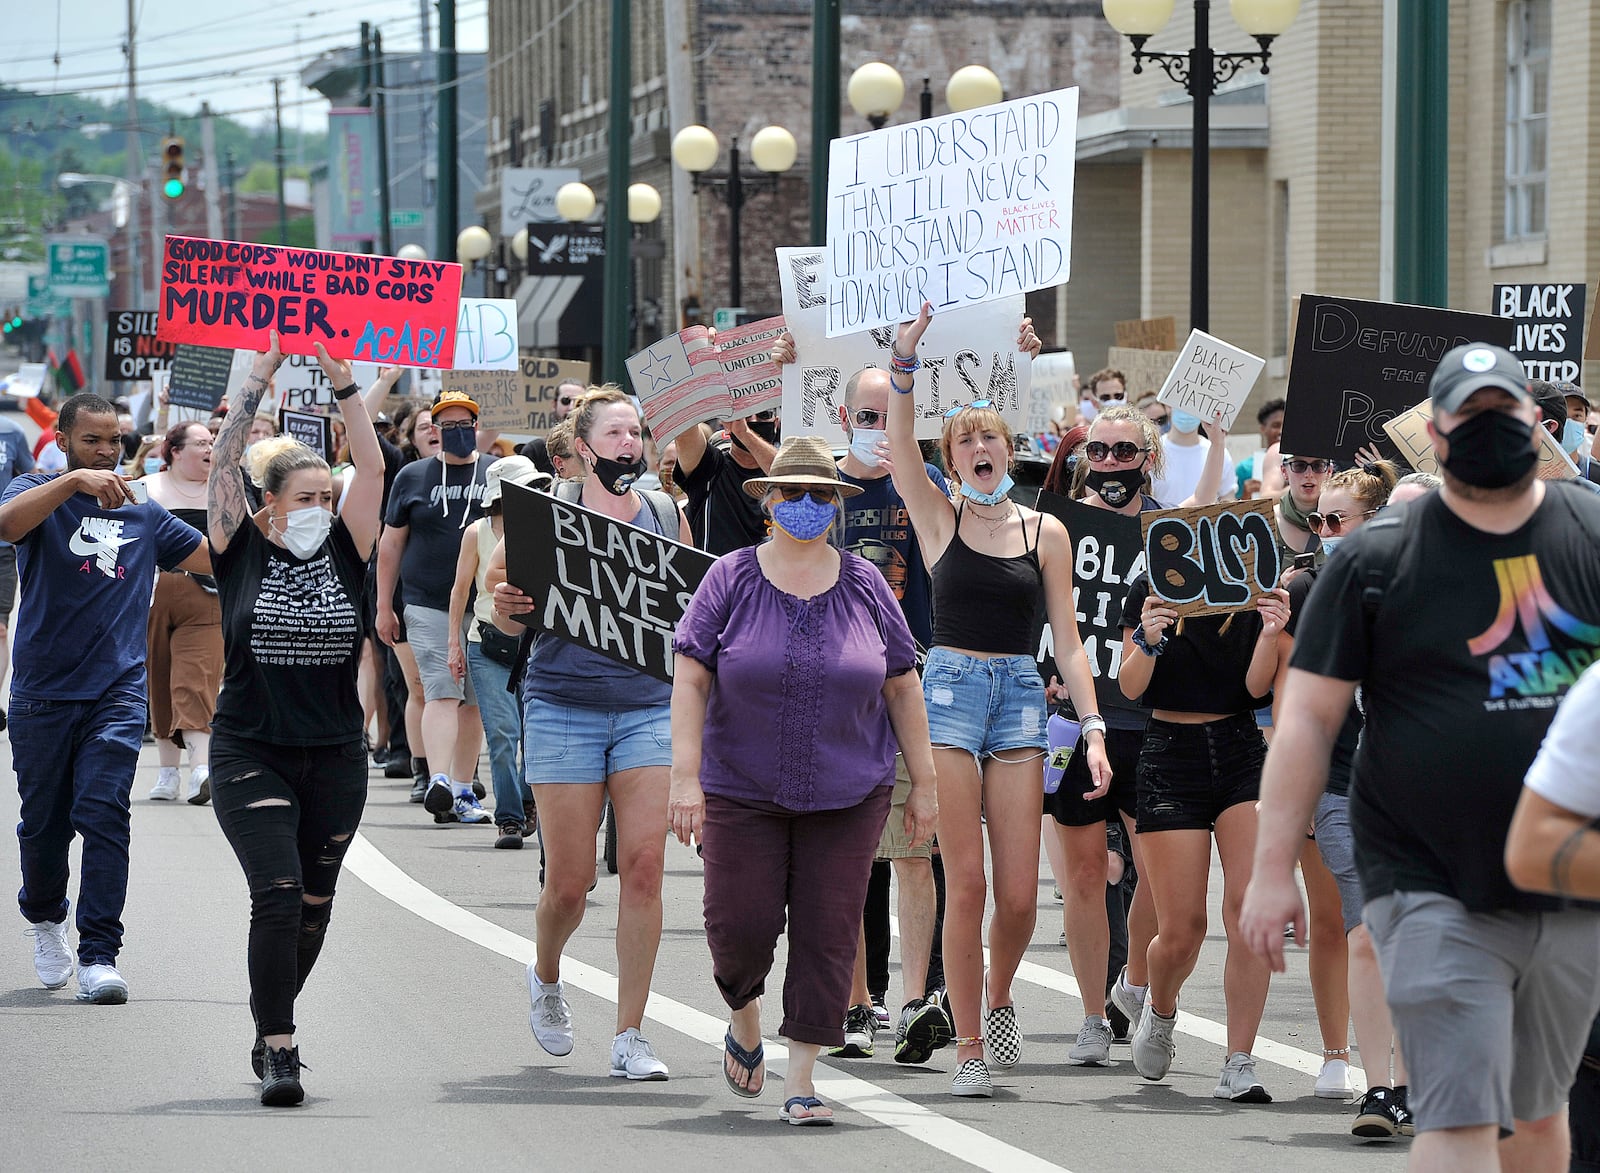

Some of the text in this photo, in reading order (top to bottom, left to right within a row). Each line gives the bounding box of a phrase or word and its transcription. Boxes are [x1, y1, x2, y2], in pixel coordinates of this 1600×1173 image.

[846, 100, 1060, 188] I UNDERSTAND
[834, 183, 898, 231] THAT
[967, 153, 1050, 205] NEVER
[1002, 200, 1056, 216] BLACK LIVES
[833, 209, 984, 278] UNDERSTAND
[995, 210, 1060, 239] MATTER
[164, 261, 434, 303] SILENT WHILE BAD COPS
[388, 259, 446, 282] STAY
[830, 266, 935, 332] HOWEVER
[938, 260, 960, 308] I
[965, 237, 1063, 301] STAND
[166, 287, 350, 339] MURDER.
[1499, 284, 1574, 318] BLACK
[117, 312, 159, 335] SILE
[353, 320, 447, 365] ACAB!
[720, 337, 748, 352] BLACK
[750, 330, 773, 342] LIVES
[114, 337, 132, 356] IS
[724, 353, 765, 372] UNITED
[1191, 345, 1245, 380] BLACK
[497, 378, 518, 392] PIG
[733, 379, 776, 399] DIVIDED
[802, 348, 1020, 428] RISM
[1184, 367, 1230, 398] LIVES
[1164, 380, 1236, 430] MATTER
[81, 516, 124, 540] NIKE
[551, 503, 687, 588] BLACK
[1075, 535, 1147, 586] BLA
[1146, 511, 1280, 606] BLM
[543, 584, 674, 677] MATT
